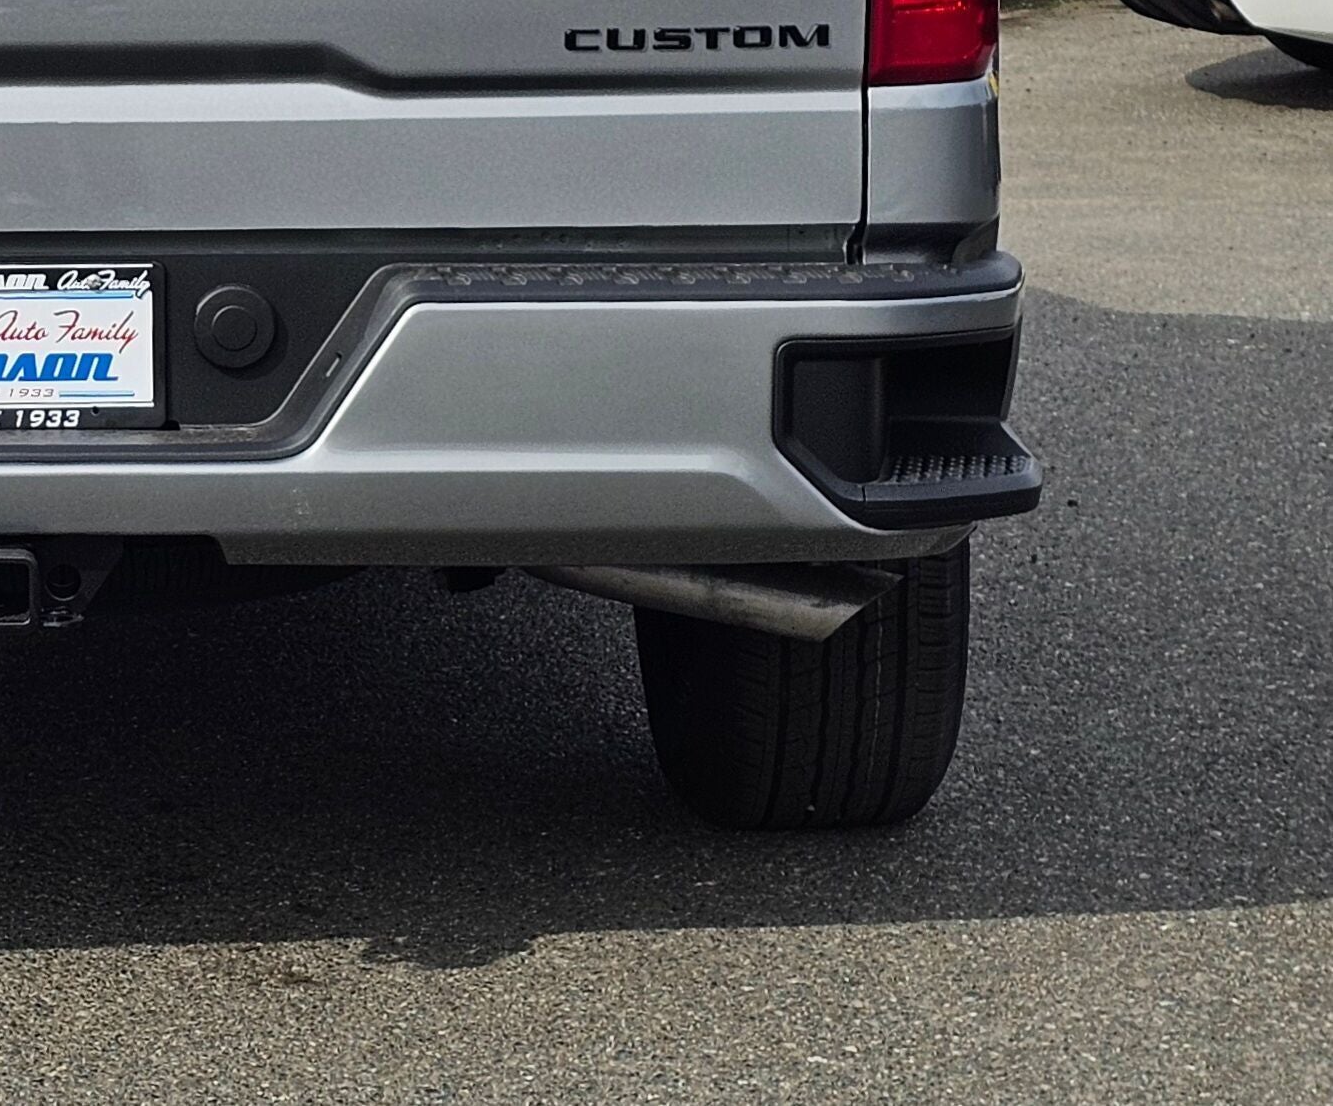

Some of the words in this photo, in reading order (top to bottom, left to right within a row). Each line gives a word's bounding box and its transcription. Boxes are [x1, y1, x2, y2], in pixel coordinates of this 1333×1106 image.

[564, 23, 831, 52] CUSTOM
[98, 269, 151, 299] Family
[54, 310, 139, 353] Family
[8, 387, 55, 398] 1933
[15, 408, 80, 427] 1933
